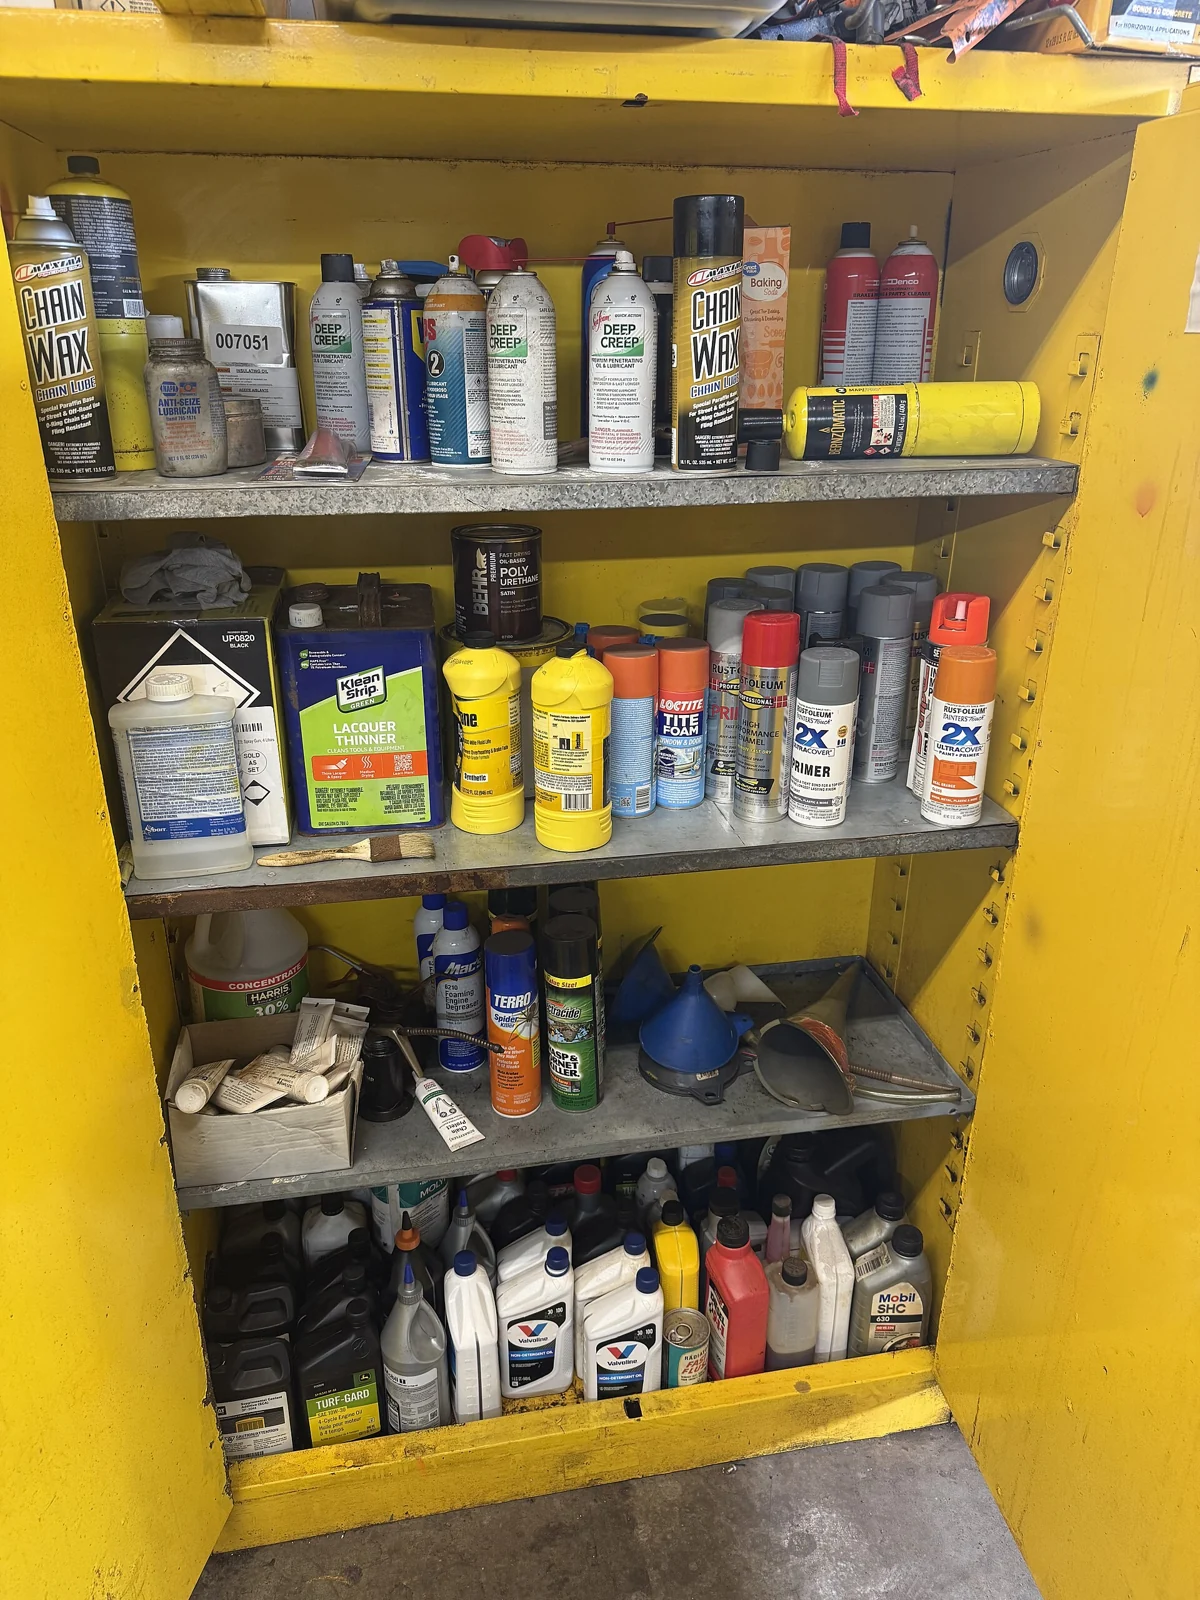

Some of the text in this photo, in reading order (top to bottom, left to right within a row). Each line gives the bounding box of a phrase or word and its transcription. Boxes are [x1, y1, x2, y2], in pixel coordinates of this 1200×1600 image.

[1132, 5, 1192, 19] BONDS TO CONCRETE
[1123, 22, 1190, 36] HORIZONTAL APPLICATIONS
[751, 278, 782, 289] Baking
[764, 288, 778, 296] Soda
[21, 281, 86, 330] CHAIN
[692, 284, 741, 332] CHAIN
[315, 323, 342, 334] DEEP
[490, 324, 517, 335] DEEP
[604, 324, 636, 335] DEEP
[215, 333, 269, 350] 007051
[314, 335, 346, 346] CREEP
[490, 337, 521, 348] CREEP
[601, 337, 640, 348] CREEP
[27, 328, 92, 384] WAX
[691, 327, 740, 382] WAX
[430, 352, 440, 374] 2
[36, 376, 96, 402] CHAIN LUBE
[691, 380, 721, 399] CHAIN
[41, 404, 58, 414] Special
[60, 400, 81, 410] Paraffin
[158, 398, 200, 407] ANTI-SEIZE
[693, 399, 711, 409] Special
[46, 412, 62, 421] Street
[69, 405, 92, 415] Off-Road
[158, 406, 201, 416] LUBRICANT
[698, 407, 713, 416] Street
[64, 416, 80, 424] Chain
[66, 420, 91, 431] Resistant
[828, 399, 847, 456] BERNZOMATIC
[500, 566, 529, 577] POLY
[500, 574, 539, 586] URETHANE
[472, 568, 489, 615] BEHR
[222, 634, 255, 642] UP0820
[341, 674, 380, 691] Klean
[350, 698, 375, 709] GREEN
[660, 699, 703, 712] LOCTITE
[944, 706, 987, 715] RUST-OLEUM
[663, 713, 699, 727] TITE
[743, 719, 760, 728] HIGH
[333, 721, 396, 734] LACQUER
[663, 726, 699, 736] FOAM
[335, 733, 396, 746] THINNER
[795, 722, 829, 748] 2X
[941, 722, 982, 746] 2X
[739, 734, 765, 746] ENAMEL
[937, 743, 983, 753] ULTRACOVER
[464, 772, 487, 781] Synthetic
[444, 957, 481, 975] Mac's
[228, 962, 301, 990] CONCENTRATE
[251, 984, 290, 1002] HARRIS
[445, 989, 474, 998] Foaming
[445, 997, 469, 1006] Engine
[446, 1000, 479, 1011] Degreaser
[494, 992, 531, 1009] TERRO
[494, 1014, 517, 1024] Spider
[569, 1054, 578, 1063] &
[446, 1119, 467, 1130] Protect
[451, 1125, 468, 1134] Chain
[879, 1293, 915, 1303] Mobil
[877, 1304, 906, 1313] SHC
[241, 1398, 267, 1406] Supplemental
[316, 1389, 370, 1410] TURF-GARD
[328, 1407, 346, 1415] 10W-30
[318, 1416, 337, 1425] 4-Cycle
[338, 1412, 355, 1420] Engine
